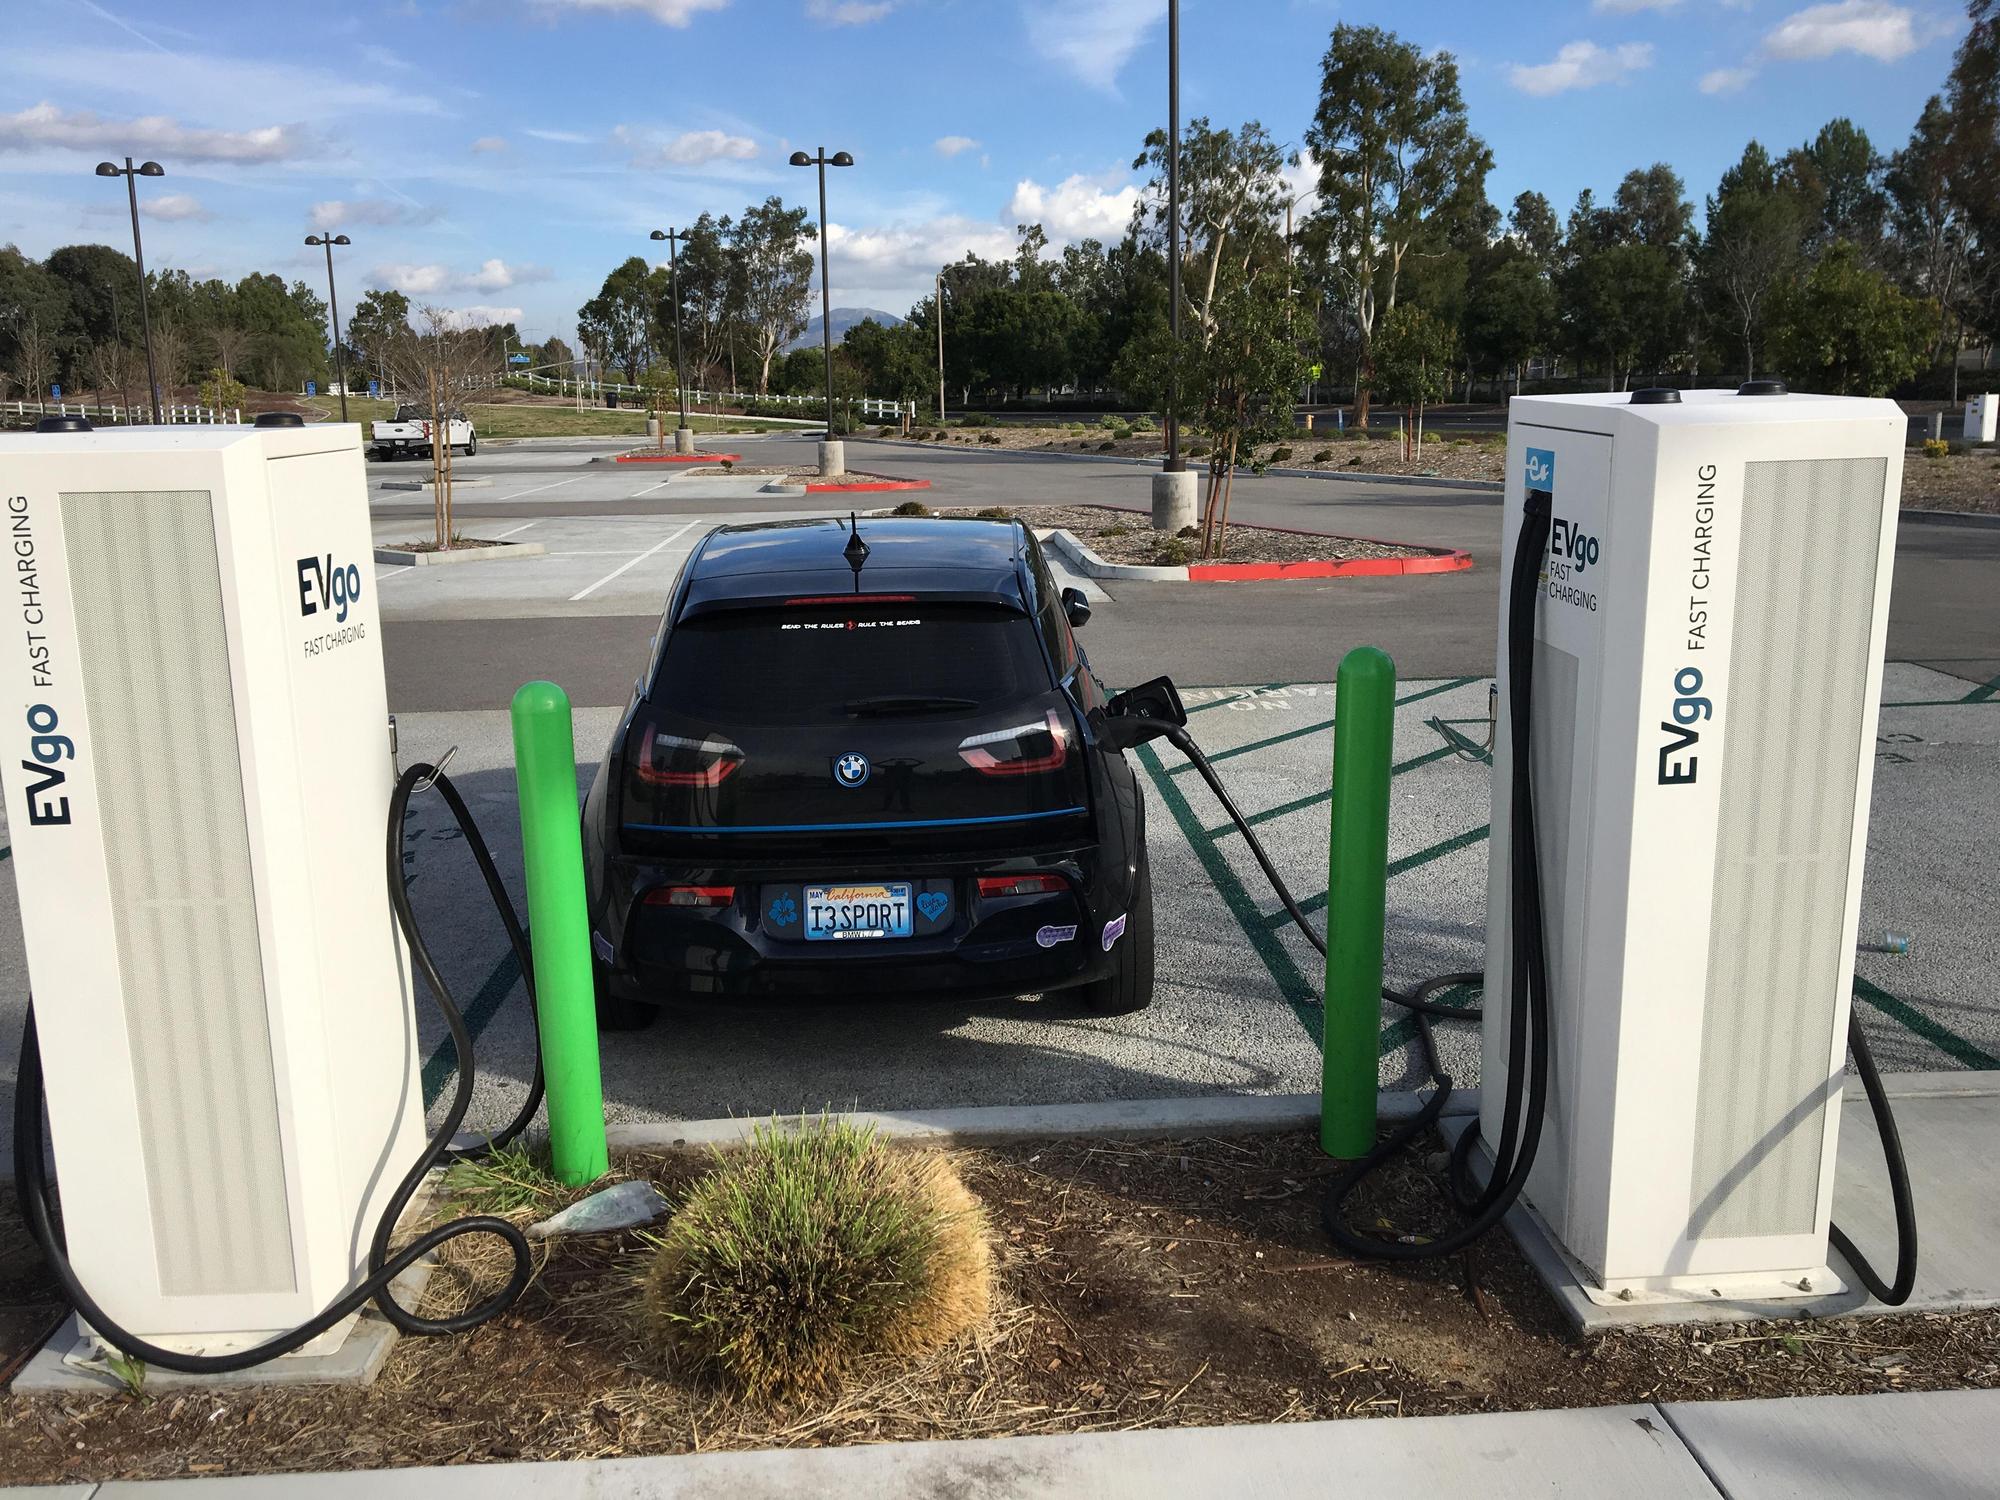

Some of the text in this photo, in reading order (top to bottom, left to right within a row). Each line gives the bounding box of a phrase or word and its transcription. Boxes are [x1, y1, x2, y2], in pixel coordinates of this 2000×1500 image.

[1551, 517, 1600, 573] EVgo
[296, 553, 361, 623] EVgo
[1550, 561, 1572, 583] FAST
[1549, 581, 1598, 612] CHARGING
[303, 622, 366, 659] FAST CHARGING
[1658, 464, 1717, 786] EVgo FAST CHARGING
[8, 495, 75, 826] EVgo FAST CHARGING
[809, 890, 823, 899] MAY
[825, 887, 892, 904] California
